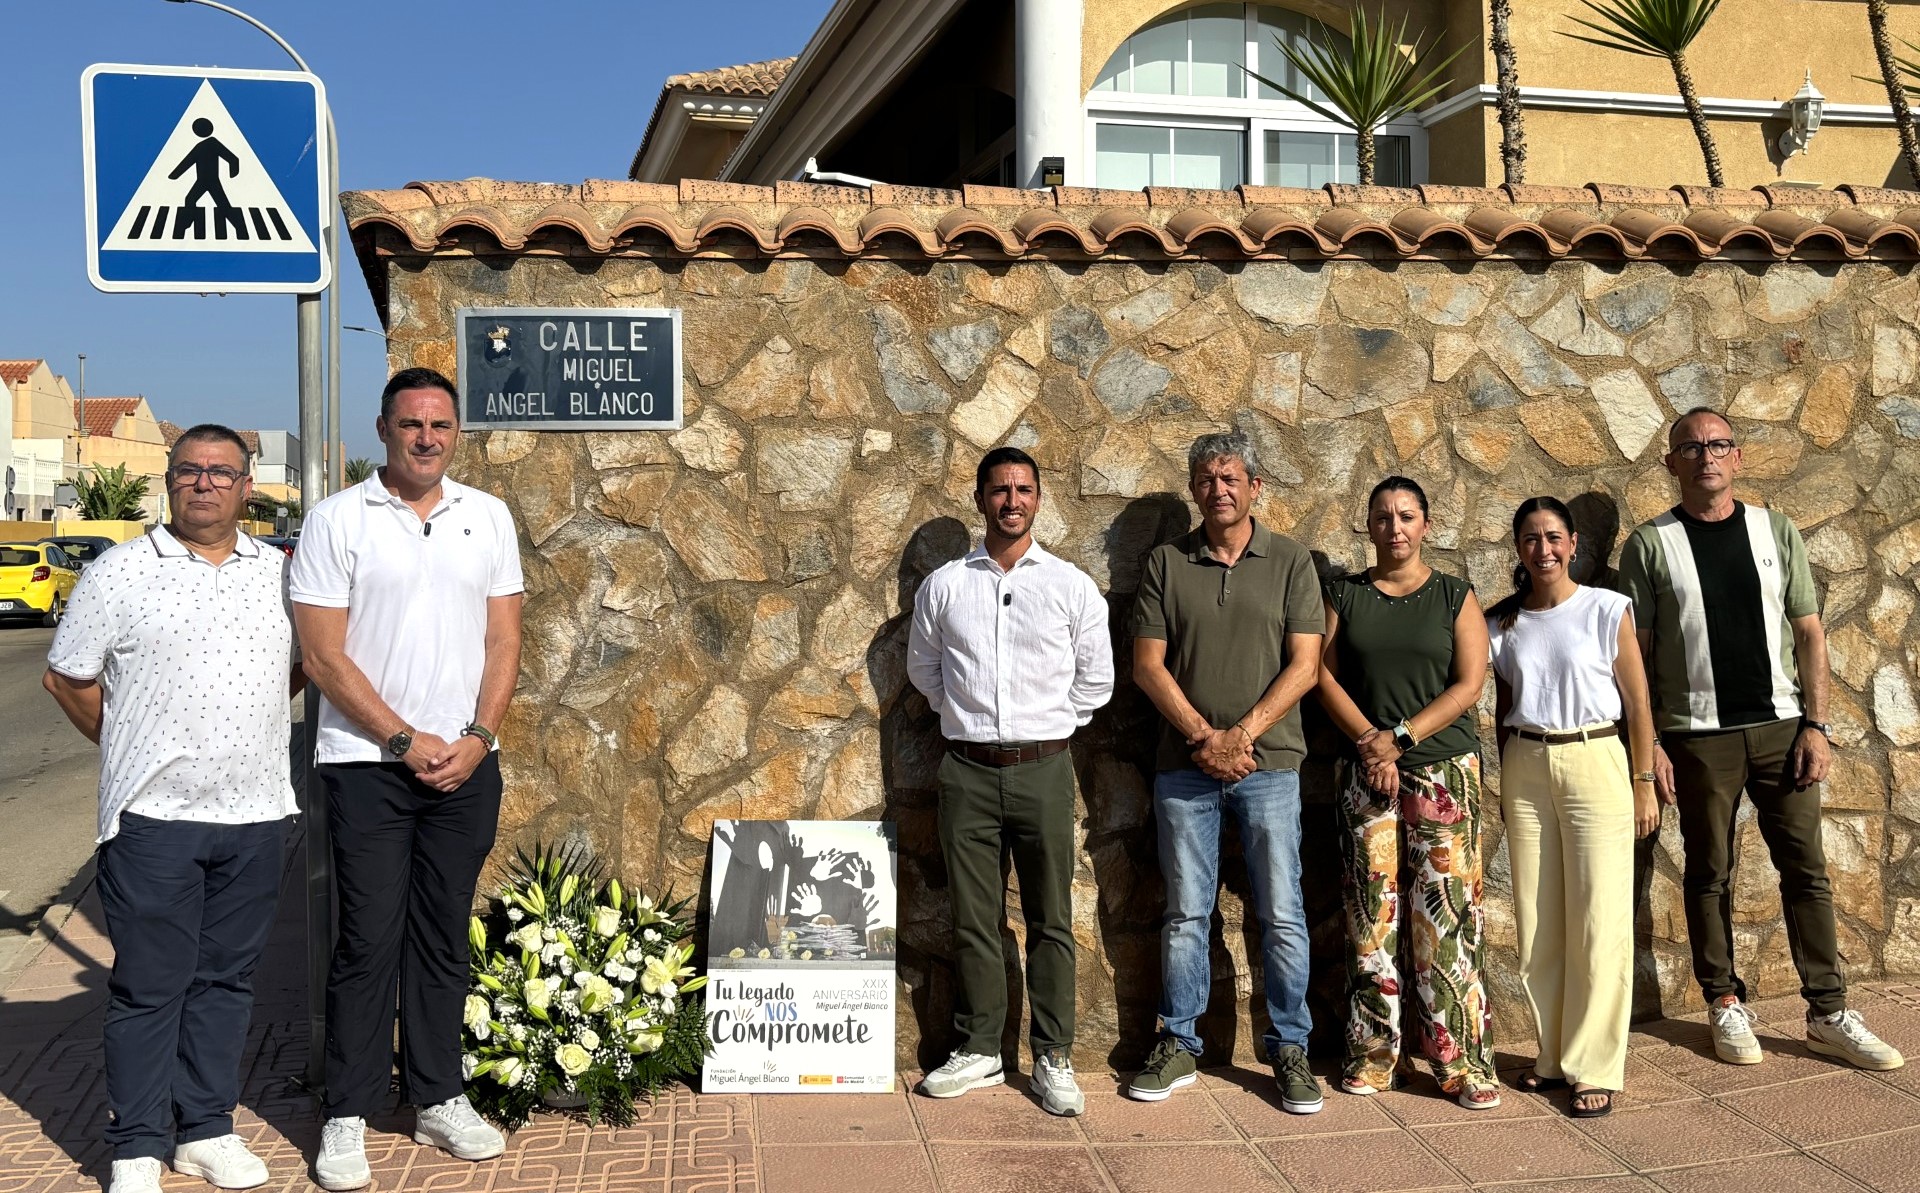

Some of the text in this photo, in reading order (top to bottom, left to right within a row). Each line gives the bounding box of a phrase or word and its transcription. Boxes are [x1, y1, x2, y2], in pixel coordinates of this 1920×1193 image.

[539, 321, 648, 351] CALLE
[563, 358, 641, 382] MIGUEL
[485, 392, 654, 416] ANGEL BLANCO
[713, 979, 794, 1007] Tu legado
[862, 979, 888, 989] XXIX
[812, 989, 888, 1000] ANIVERSARIO
[764, 1002, 798, 1022] NOS
[815, 1000, 888, 1011] Miguel Ángel Blanco
[709, 1073, 790, 1085] Miguel Ángel Blanco
